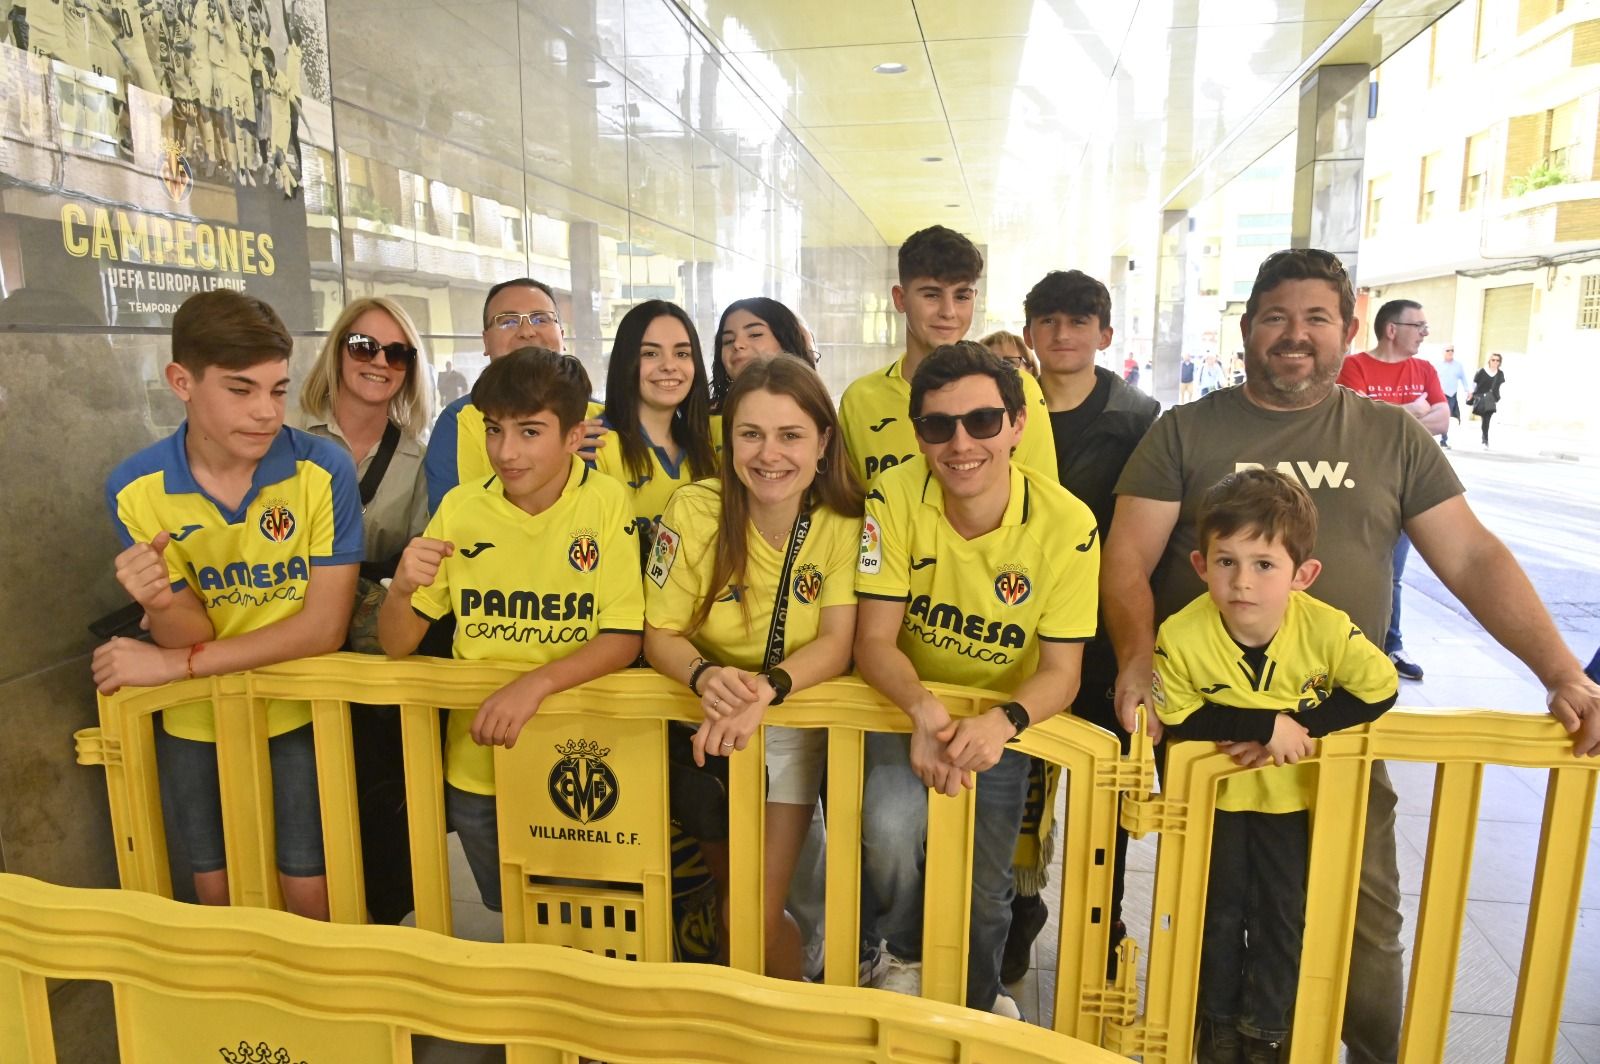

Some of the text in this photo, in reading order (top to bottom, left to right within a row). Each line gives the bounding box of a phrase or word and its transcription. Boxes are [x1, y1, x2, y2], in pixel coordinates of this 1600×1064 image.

[61, 203, 275, 276] CAMPEONES
[108, 267, 144, 289] UEFA
[148, 272, 200, 292] EUROPA
[128, 301, 181, 315] TEMPORA
[188, 555, 309, 590] AMESA
[860, 555, 878, 567] iga
[460, 588, 595, 622] PAMESA
[465, 621, 590, 644] cerámica
[908, 594, 1026, 649] AMESA
[529, 825, 641, 846] VILLARREAL C.F.
